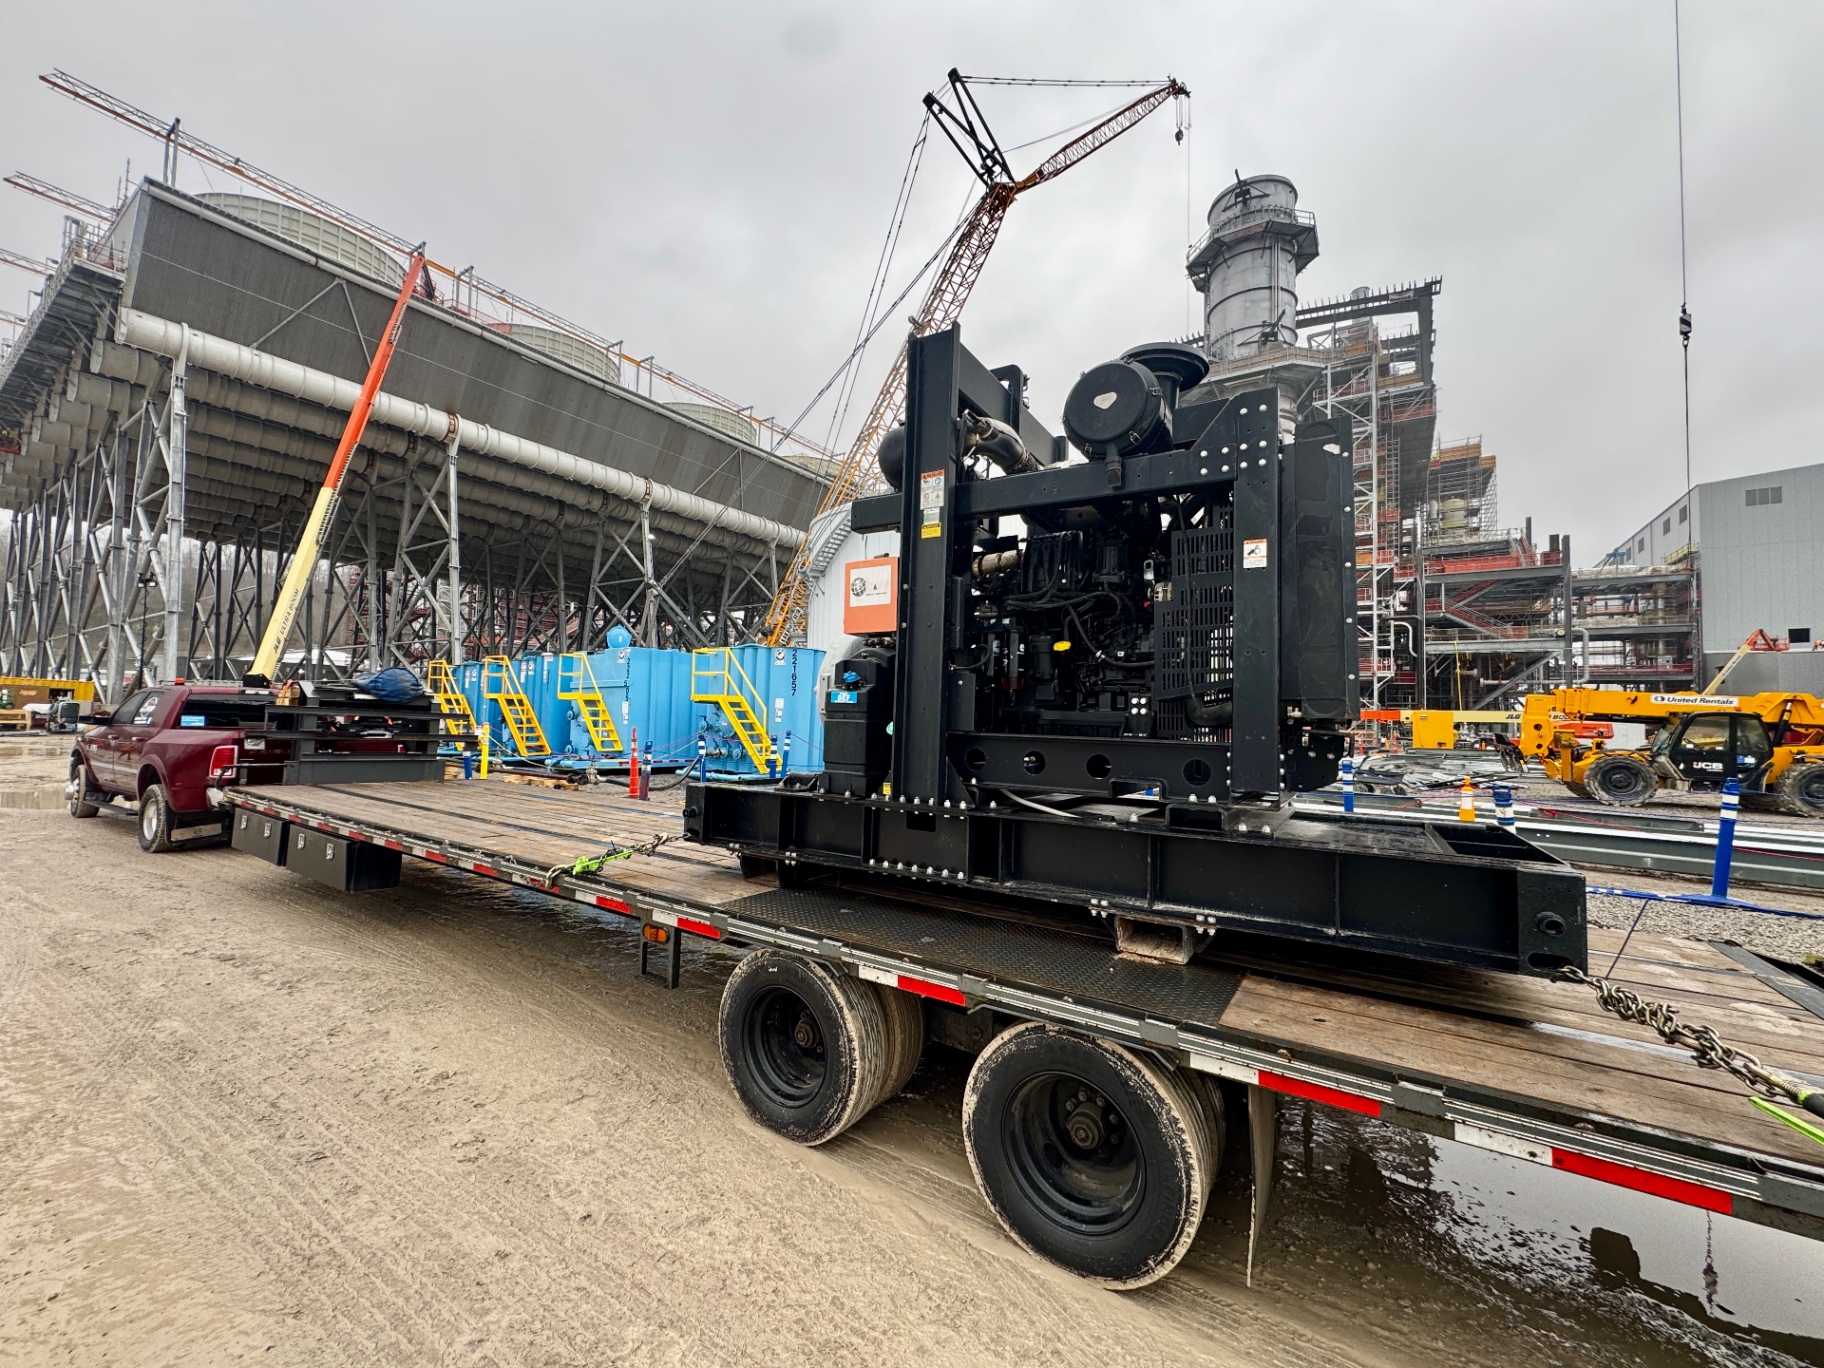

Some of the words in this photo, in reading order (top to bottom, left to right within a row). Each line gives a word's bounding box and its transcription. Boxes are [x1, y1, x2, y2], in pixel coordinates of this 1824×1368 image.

[280, 611, 292, 635] ULTRA
[289, 588, 300, 611] BOOM
[1667, 696, 1698, 704] United
[1699, 697, 1734, 705] Rentals
[1692, 761, 1724, 770] JCB
